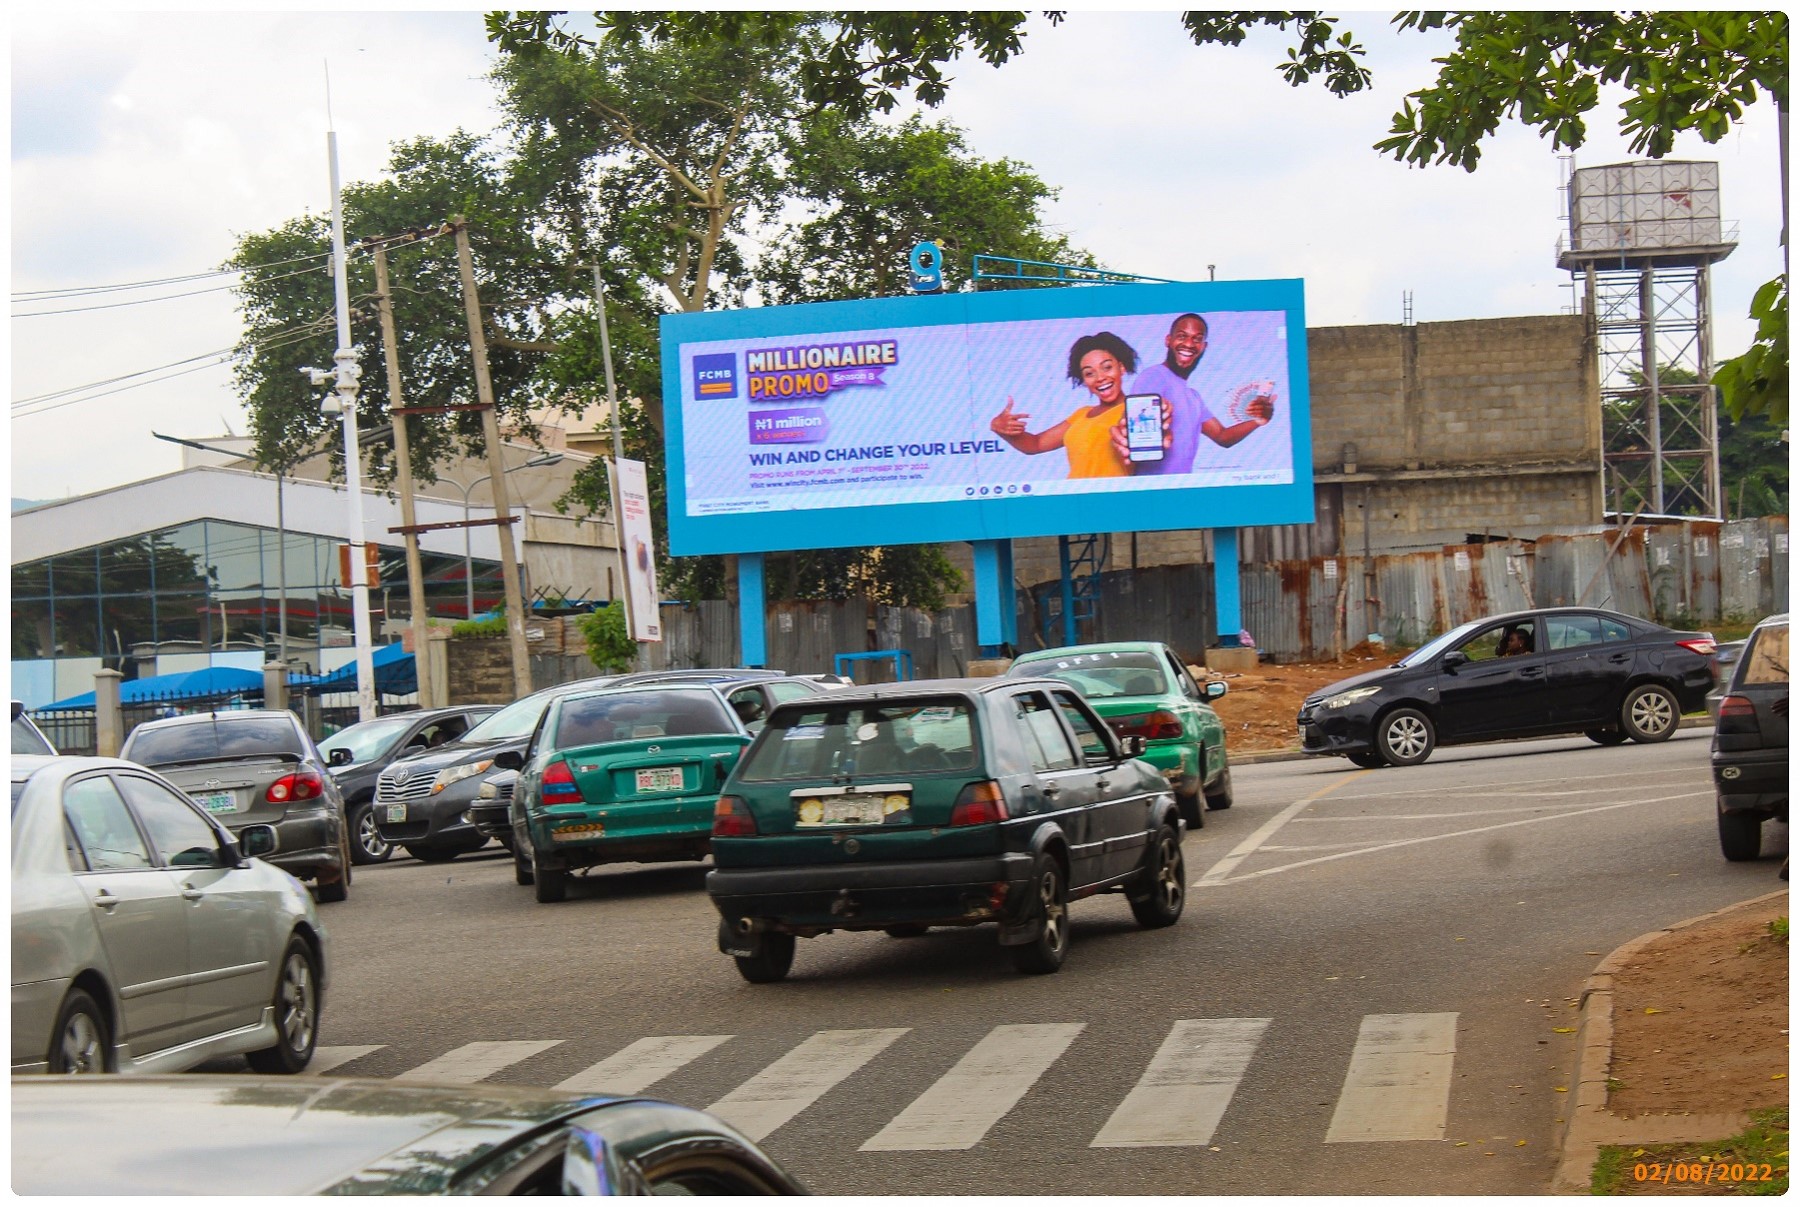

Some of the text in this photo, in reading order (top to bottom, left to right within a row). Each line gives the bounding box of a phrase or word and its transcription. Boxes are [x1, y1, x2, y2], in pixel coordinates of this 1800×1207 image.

[747, 342, 897, 373] MILLIONAIRE
[698, 369, 732, 380] FCMB
[834, 373, 867, 383] Season
[750, 372, 829, 398] PROMO
[775, 416, 822, 429] million
[749, 439, 1005, 467] WIN AND CHANGE YOUR LEVEL
